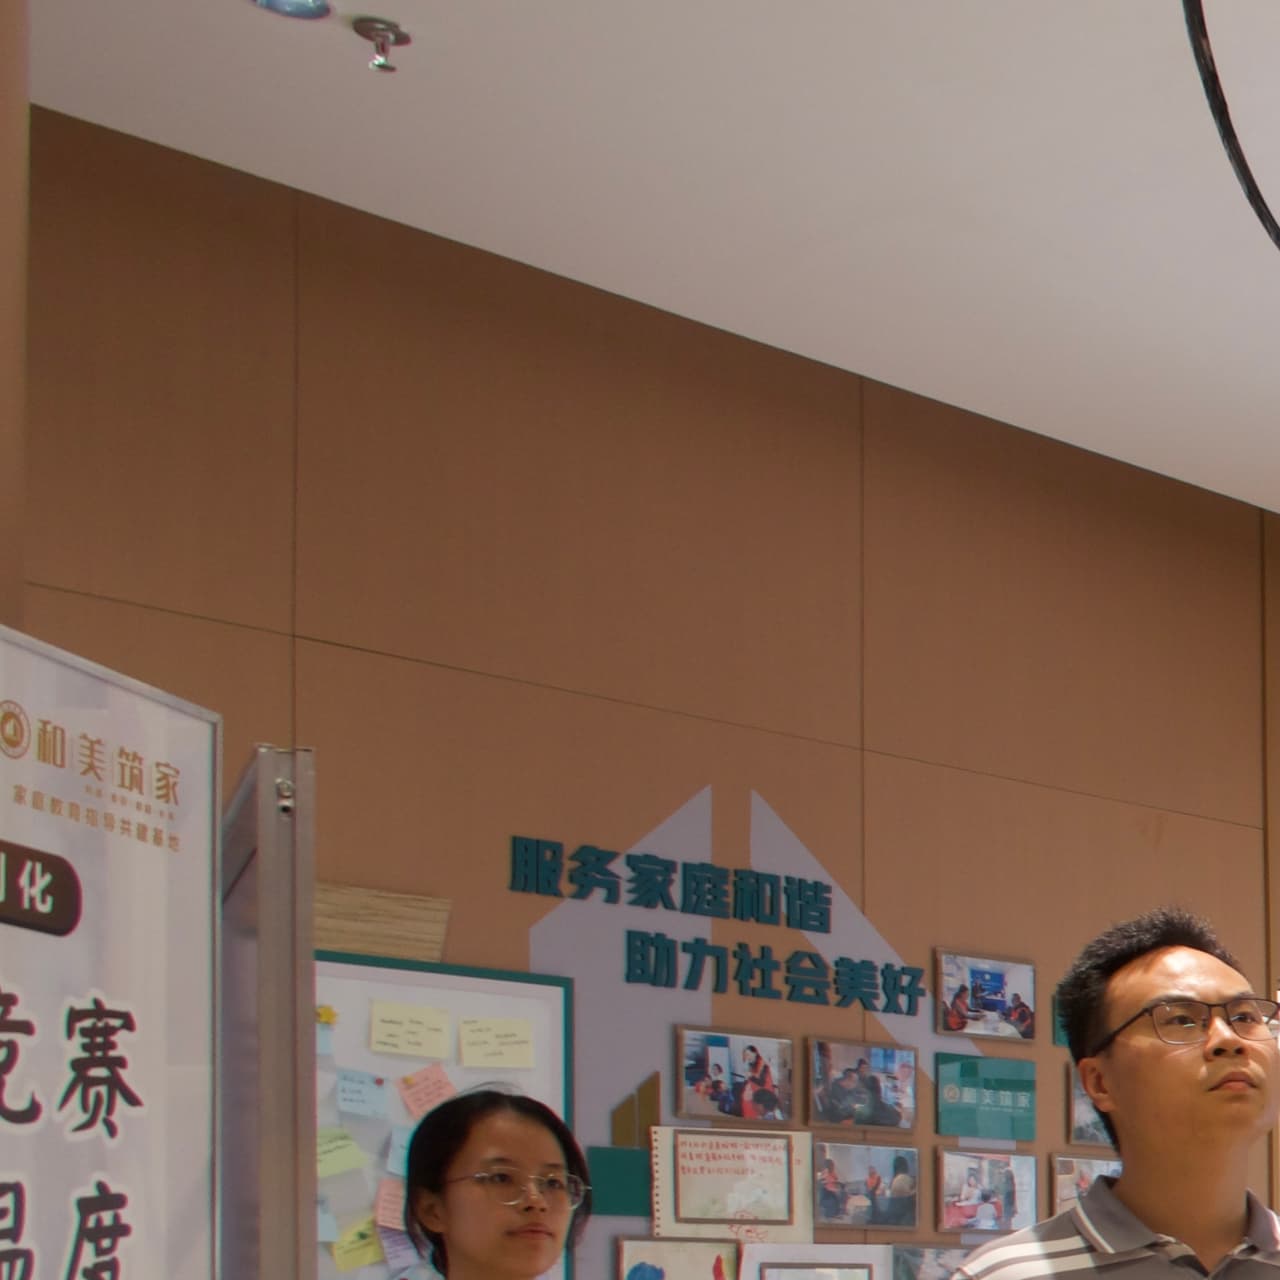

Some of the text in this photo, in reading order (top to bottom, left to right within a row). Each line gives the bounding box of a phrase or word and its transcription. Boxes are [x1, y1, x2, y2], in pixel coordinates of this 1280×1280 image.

[38, 718, 180, 806] 和美筑家
[0, 851, 54, 913] 化
[510, 835, 832, 934] 服务家庭和谐
[624, 929, 926, 1017] 助力社会美好
